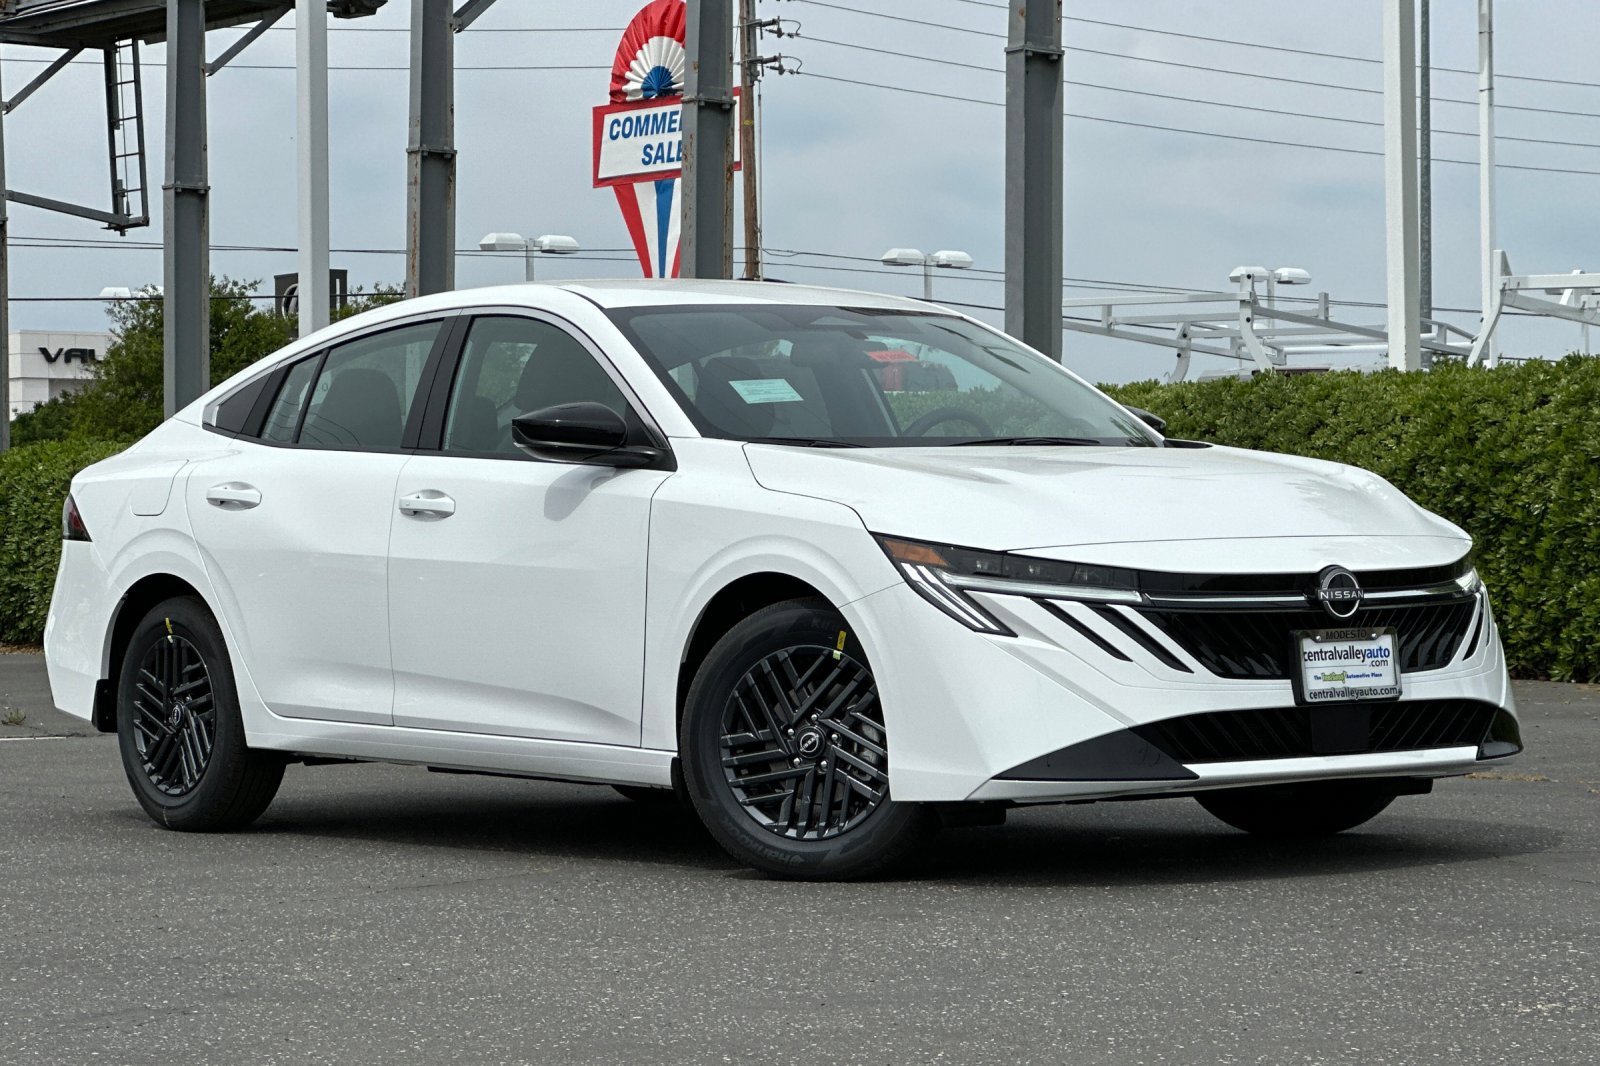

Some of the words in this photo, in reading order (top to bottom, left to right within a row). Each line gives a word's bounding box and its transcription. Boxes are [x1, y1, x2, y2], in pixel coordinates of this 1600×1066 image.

[609, 110, 682, 140] COMME
[1319, 590, 1364, 599] NISSAN
[1325, 630, 1367, 640] MODESTO
[1303, 645, 1390, 663] centralvalleyauto
[1369, 659, 1389, 668] .com
[1309, 686, 1398, 700] centralvalleyauto.com
